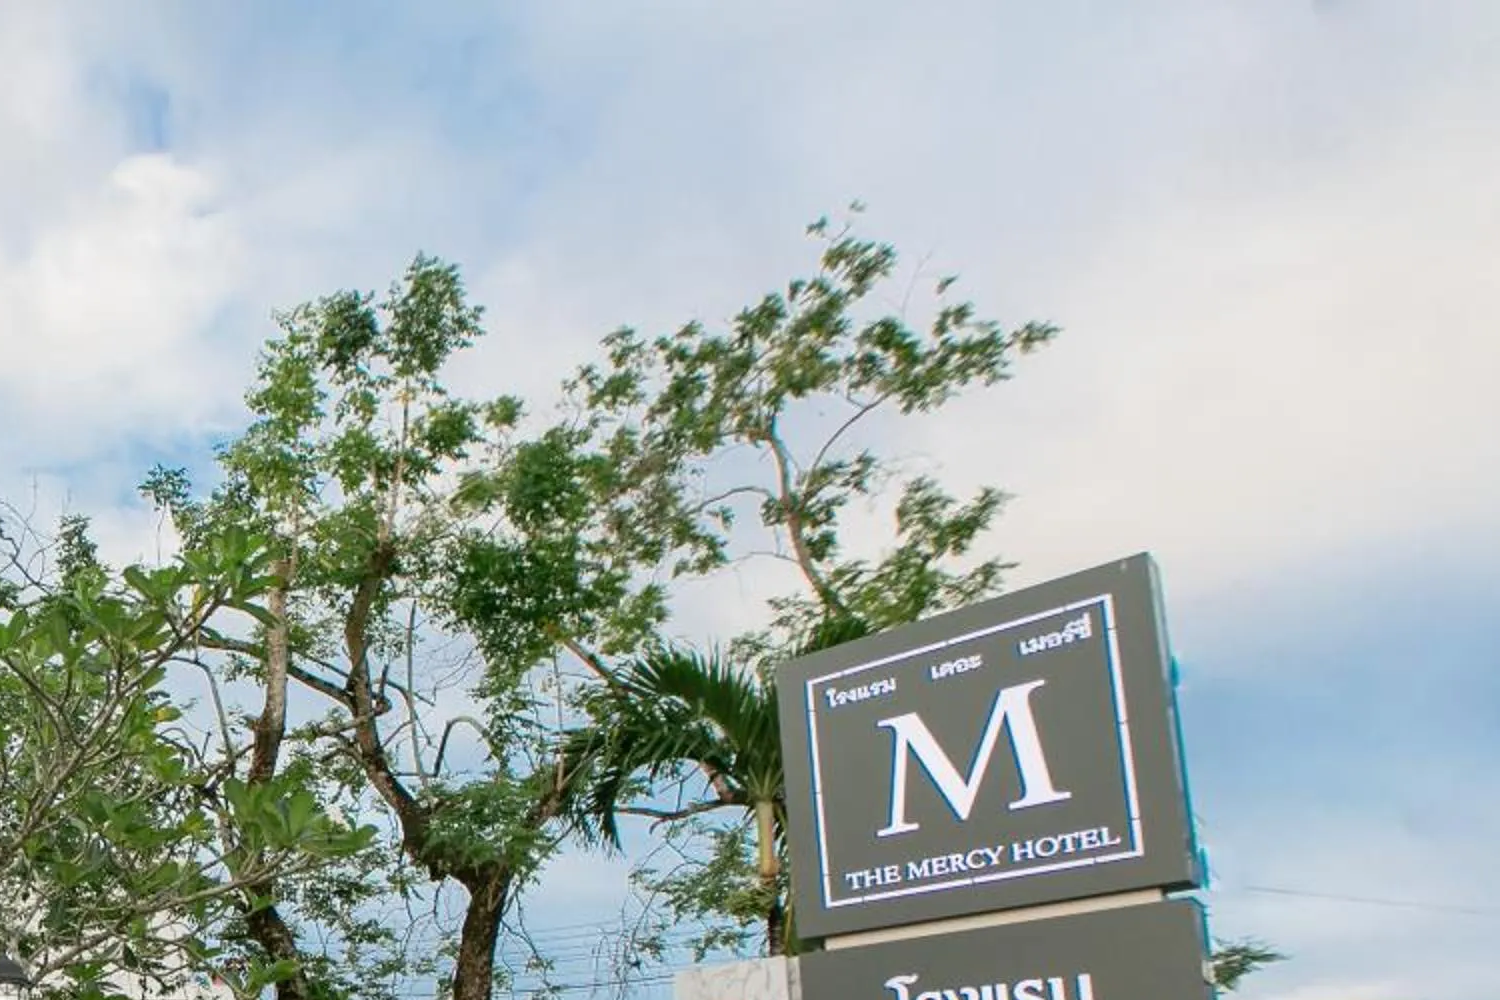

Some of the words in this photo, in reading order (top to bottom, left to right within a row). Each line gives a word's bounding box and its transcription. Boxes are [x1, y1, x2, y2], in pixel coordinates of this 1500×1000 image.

[877, 679, 1072, 837] M
[845, 864, 902, 891] THE
[907, 845, 1005, 881] MERCY
[1012, 827, 1122, 863] HOTEL
